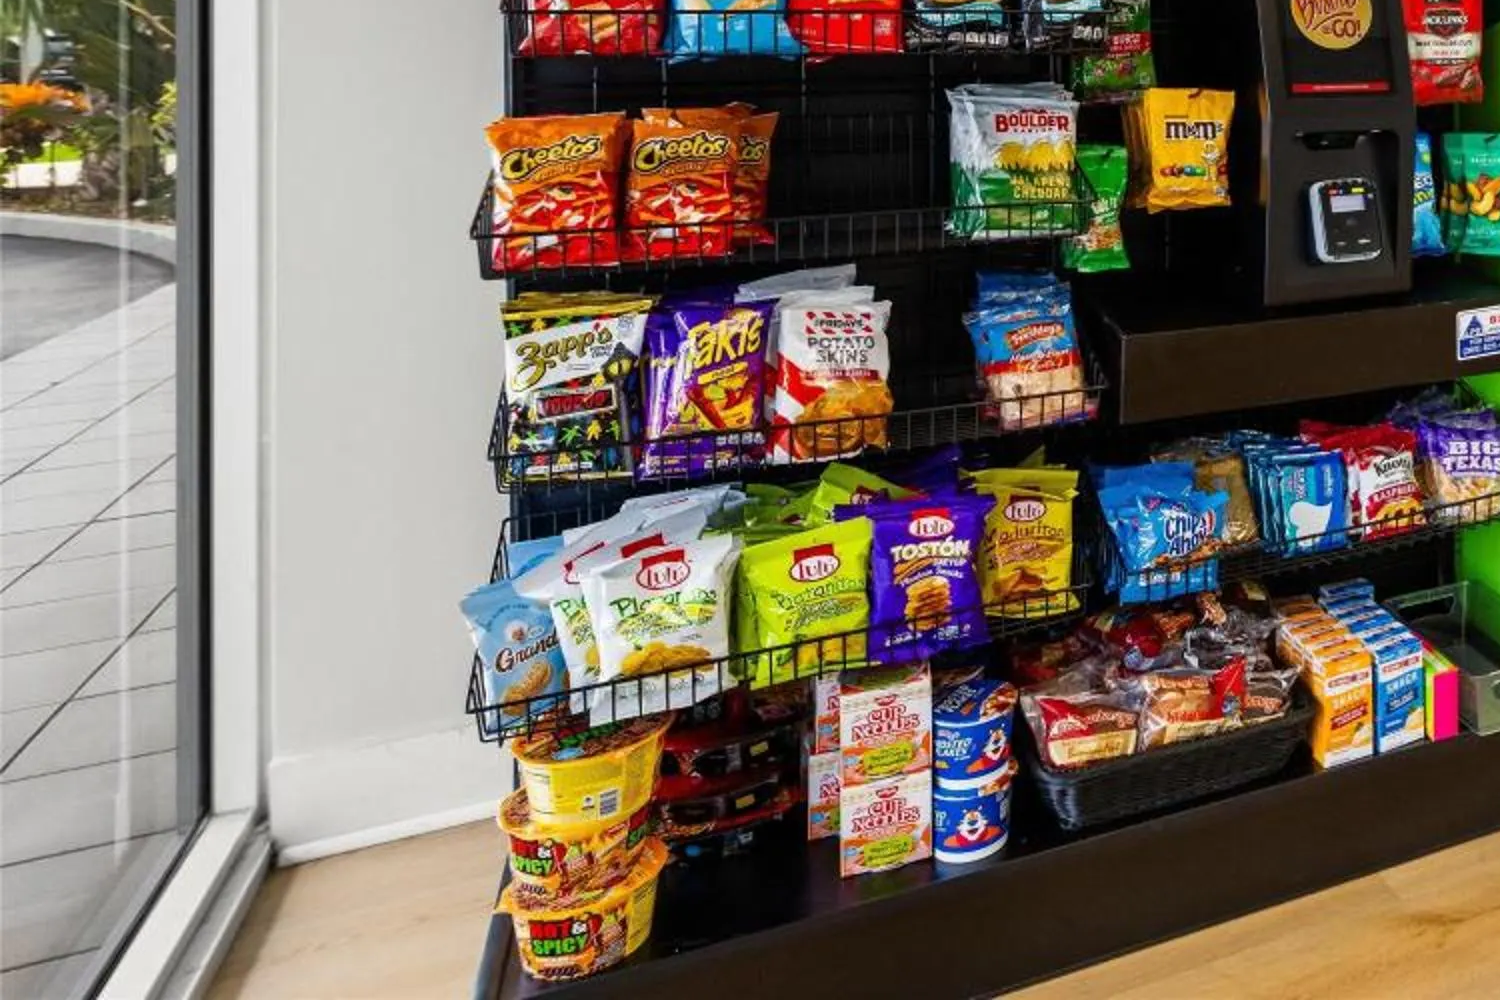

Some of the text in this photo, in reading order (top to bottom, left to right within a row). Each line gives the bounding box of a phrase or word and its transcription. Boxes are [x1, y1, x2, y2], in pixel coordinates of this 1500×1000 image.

[994, 112, 1070, 134] BOULDER
[501, 135, 601, 181] Cheetos
[633, 131, 729, 172] Cheetos
[807, 334, 876, 350] POTATO
[816, 349, 869, 364] SKINS
[1448, 441, 1500, 455] BIG
[532, 935, 588, 957] SPICY
